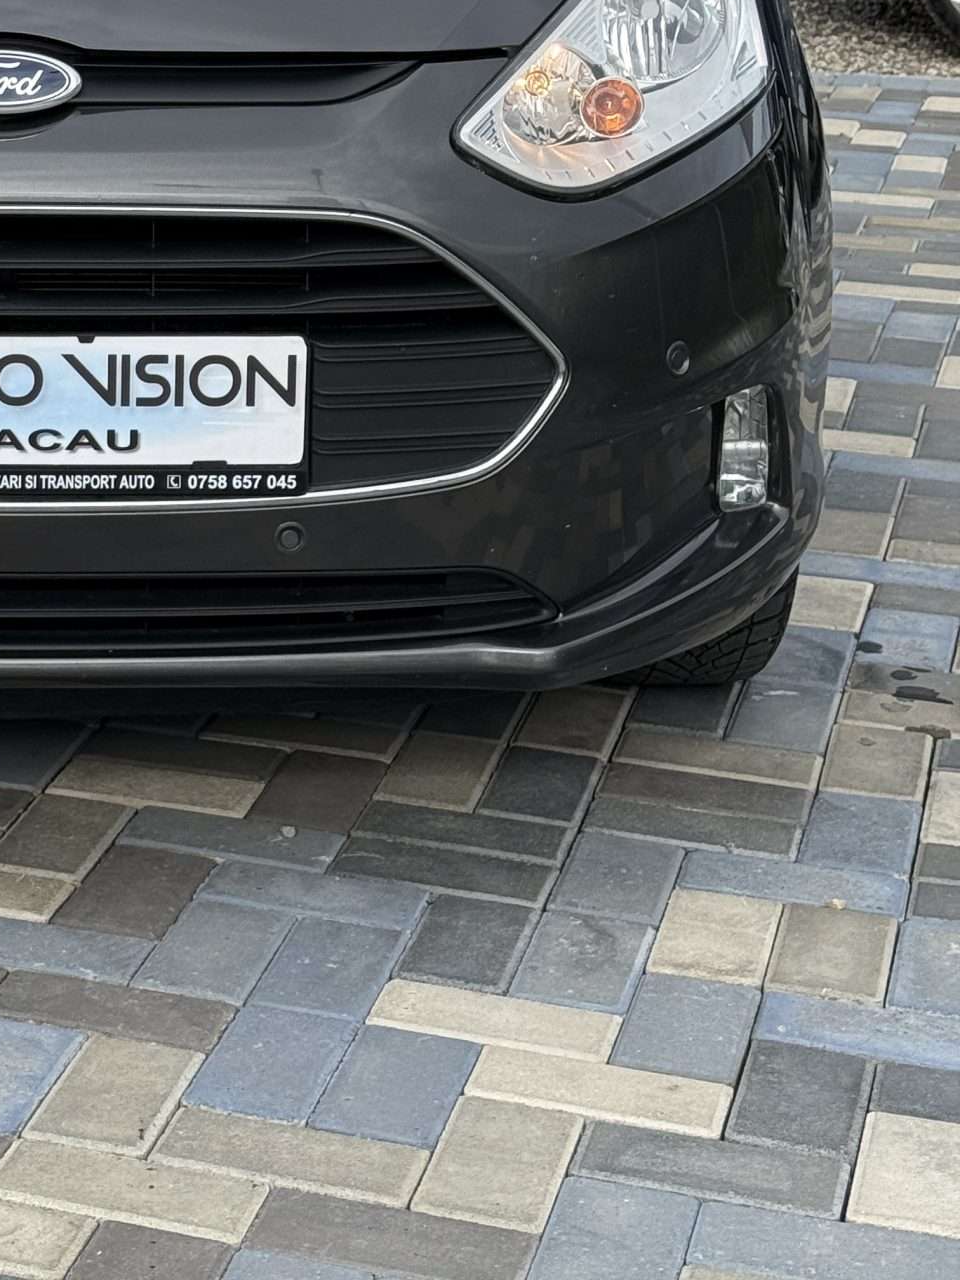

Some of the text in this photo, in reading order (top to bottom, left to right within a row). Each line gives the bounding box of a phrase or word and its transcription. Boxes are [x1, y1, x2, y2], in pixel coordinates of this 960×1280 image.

[61, 353, 297, 407] VISION
[25, 474, 38, 489] SI
[40, 474, 117, 489] TRANSPORT
[120, 474, 155, 489] AUTO
[187, 474, 228, 489] 0758
[232, 474, 262, 489] 657
[266, 474, 297, 489] 045
